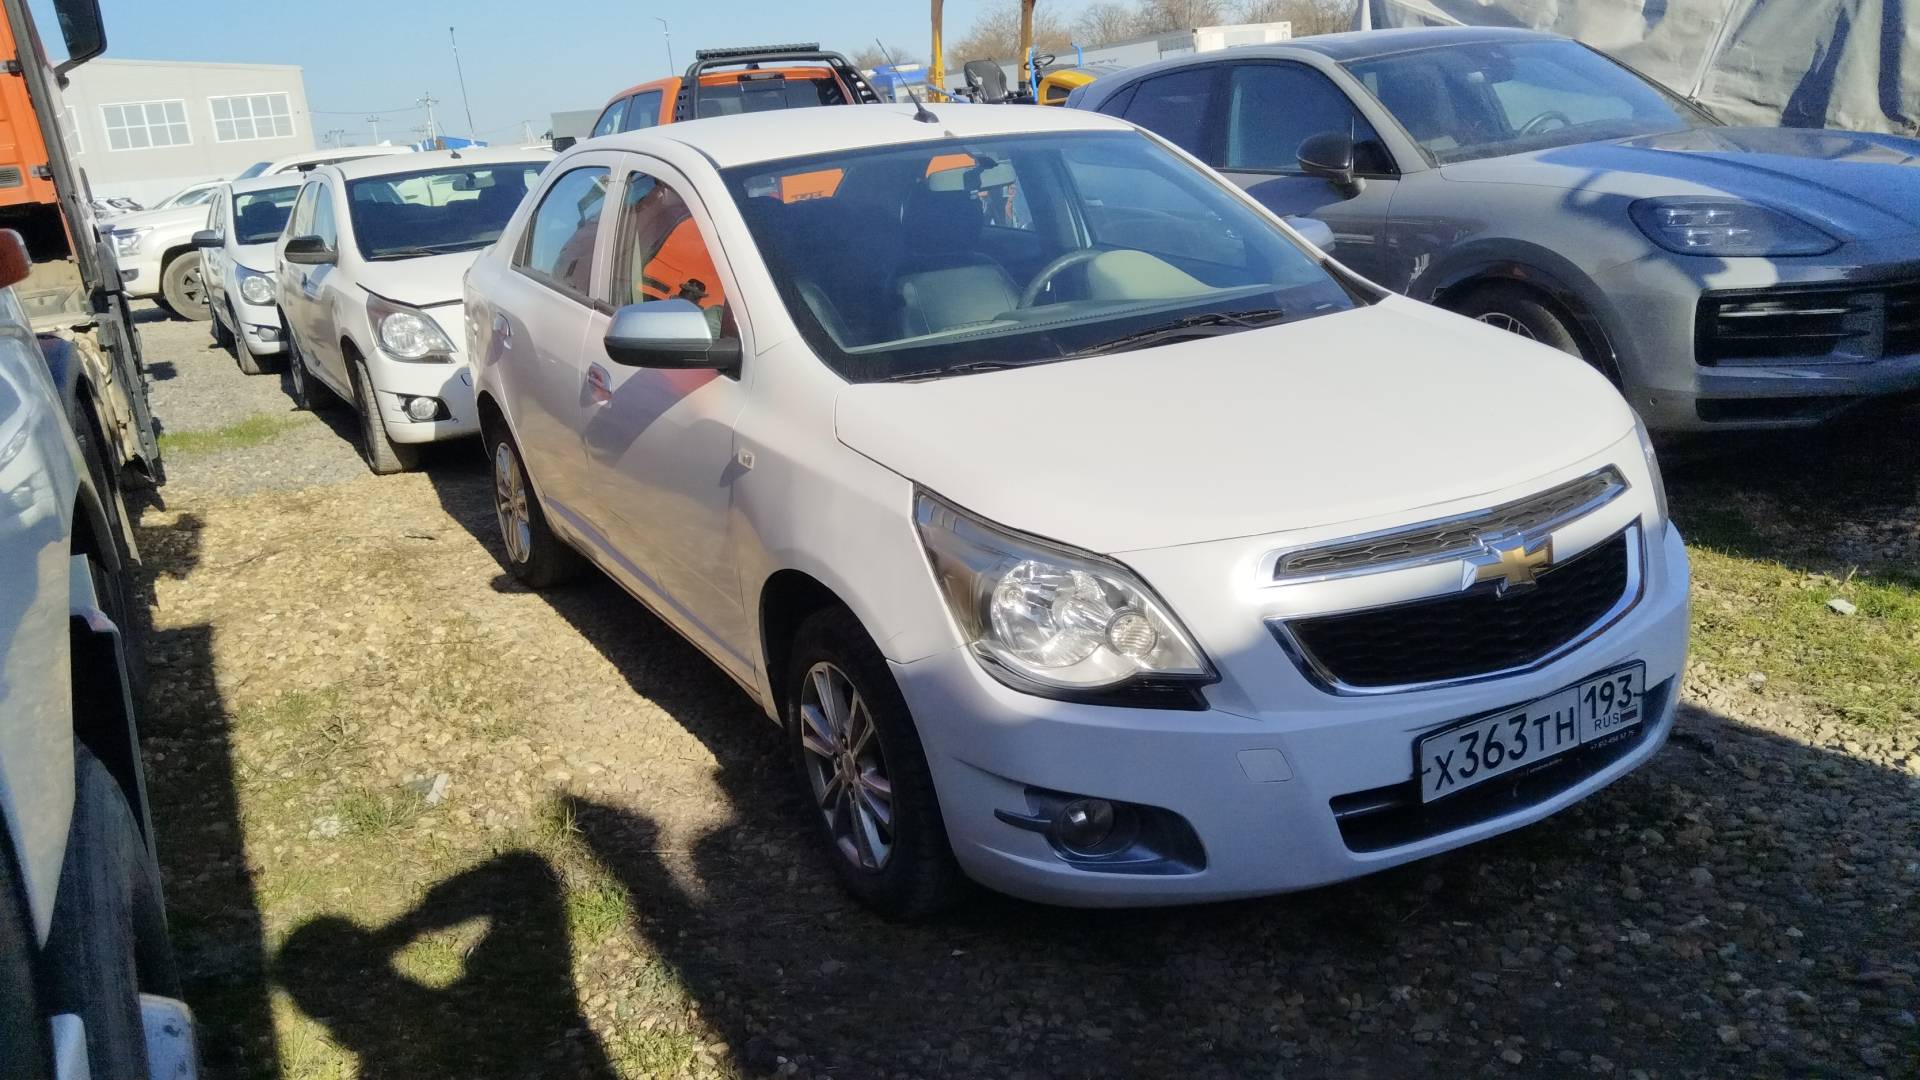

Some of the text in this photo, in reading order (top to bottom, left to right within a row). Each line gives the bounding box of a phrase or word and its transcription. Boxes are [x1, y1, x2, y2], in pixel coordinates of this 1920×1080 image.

[1435, 673, 1633, 790] Х363ТН 193
[1594, 713, 1620, 732] RUS
